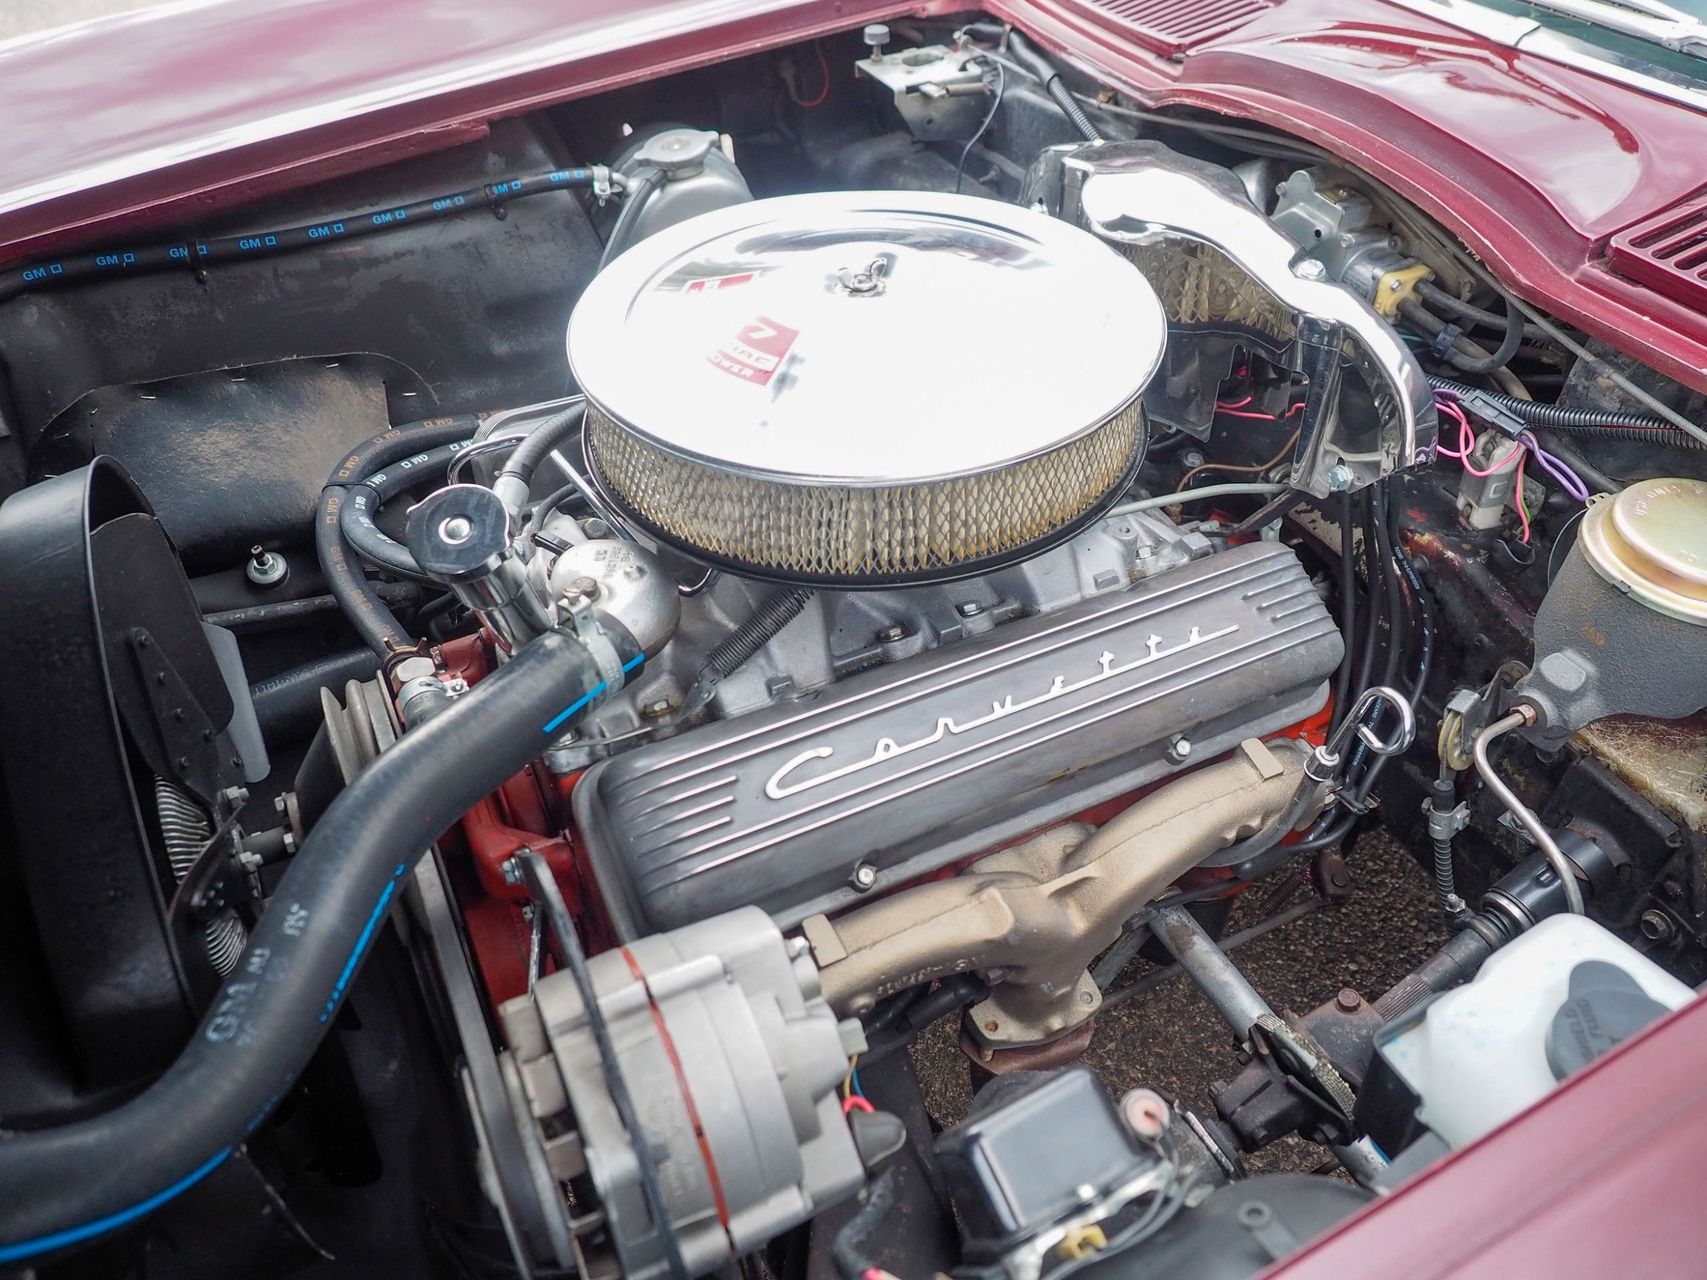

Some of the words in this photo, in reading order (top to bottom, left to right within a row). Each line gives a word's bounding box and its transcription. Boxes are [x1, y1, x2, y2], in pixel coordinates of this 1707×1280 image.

[22, 266, 47, 282] GM
[96, 254, 119, 267] GM
[239, 237, 262, 250] GM
[308, 227, 331, 239] GM
[372, 212, 393, 225] GM
[432, 199, 451, 212] GM
[549, 170, 569, 182] GM
[344, 455, 360, 469] GM
[410, 454, 429, 466] GM
[371, 473, 387, 485] GM
[327, 497, 339, 513] GM
[765, 624, 1241, 800] Corvette
